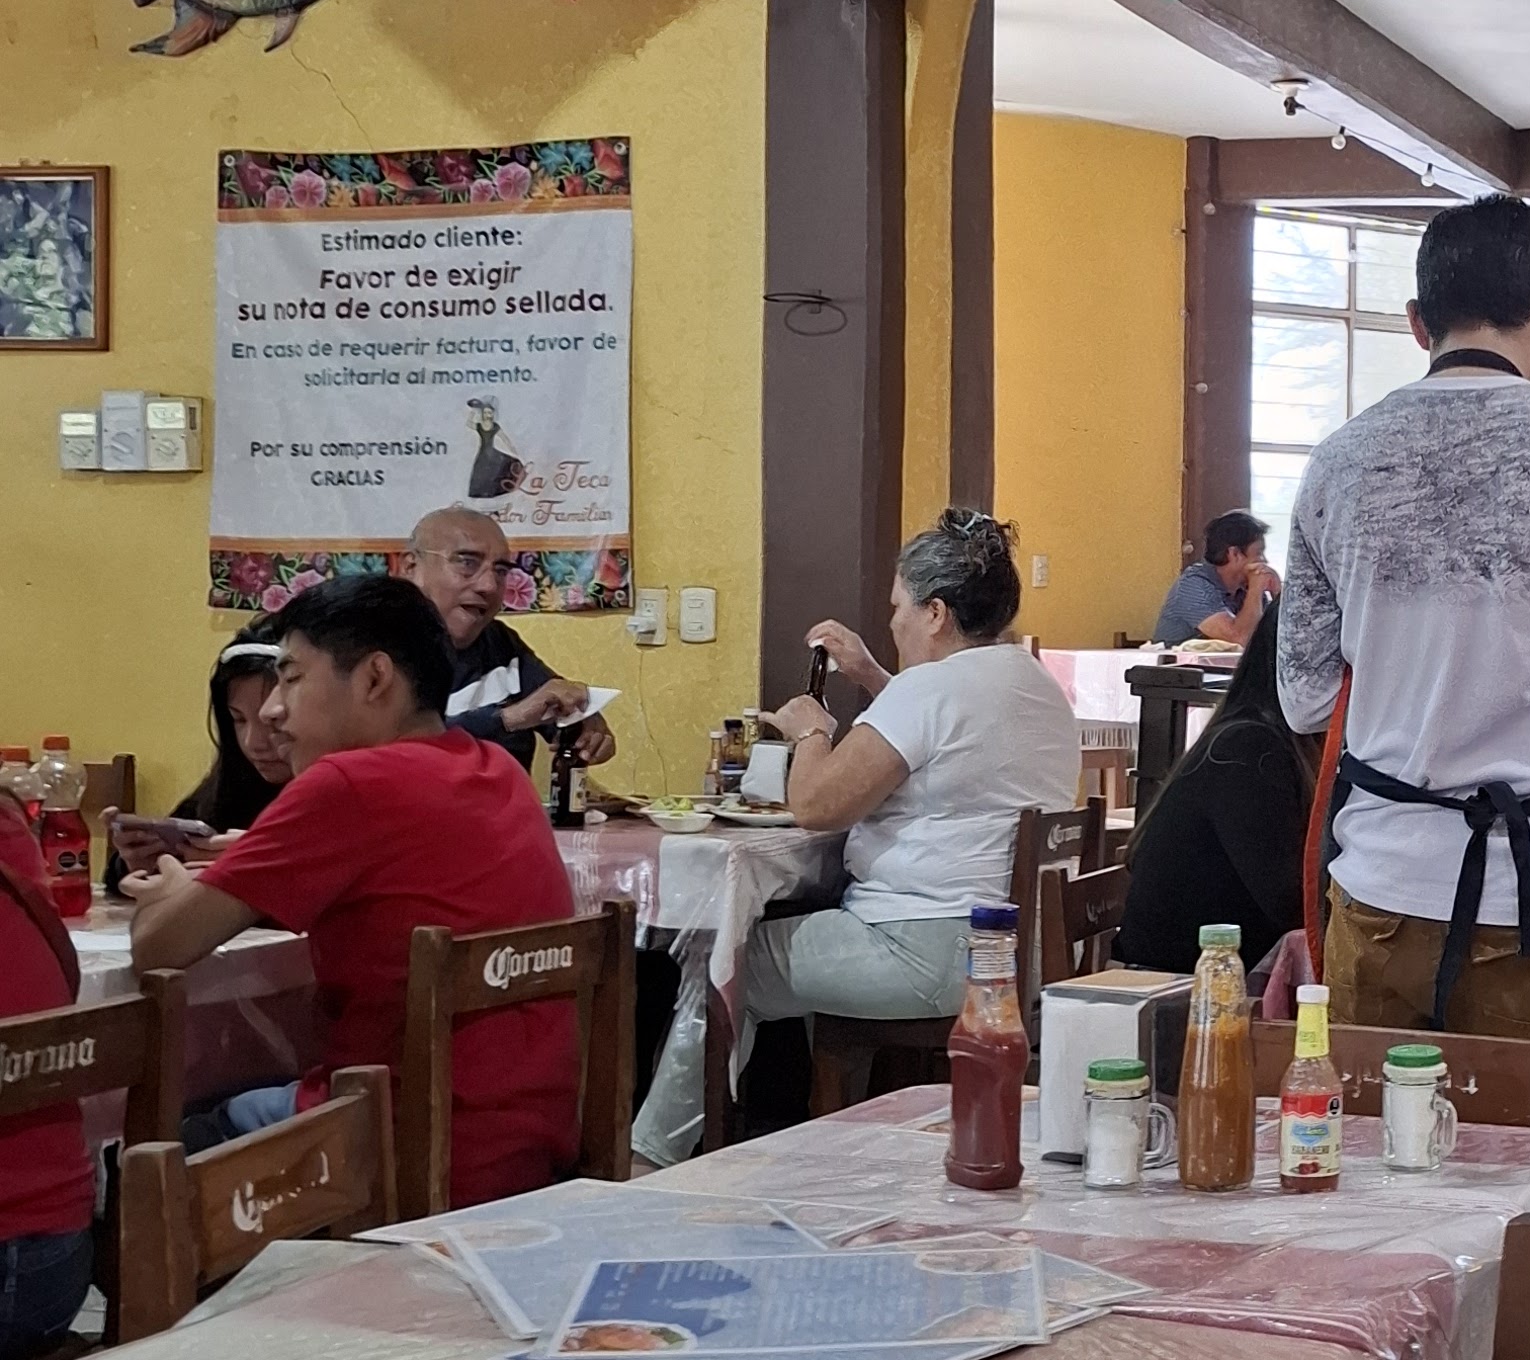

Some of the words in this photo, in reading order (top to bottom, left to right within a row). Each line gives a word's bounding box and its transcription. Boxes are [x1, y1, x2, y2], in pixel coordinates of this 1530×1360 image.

[320, 228, 427, 252] Estimado
[434, 225, 523, 248] cliente:
[319, 268, 396, 290] Favor
[404, 264, 438, 288] de
[447, 260, 522, 291] exigir
[237, 301, 267, 321] su
[273, 297, 326, 321] nota
[335, 297, 371, 320] de
[379, 297, 497, 319] consumo
[505, 288, 614, 315] sellada.
[231, 341, 257, 359] En
[263, 343, 303, 359] caso
[307, 338, 333, 357] de
[339, 336, 431, 360] requerir
[436, 336, 521, 356] factura,
[526, 334, 585, 353] favor
[593, 332, 618, 351] de
[304, 366, 400, 387] solicitarla
[406, 367, 426, 385] al
[431, 365, 538, 384] momento.
[250, 441, 285, 457] Por
[290, 442, 313, 457] su
[319, 436, 448, 460] comprensión
[310, 469, 385, 487] GRACIAS
[501, 461, 547, 496] La
[553, 460, 612, 492] Teca
[483, 945, 574, 990] Corona
[0, 1037, 97, 1088] orona
